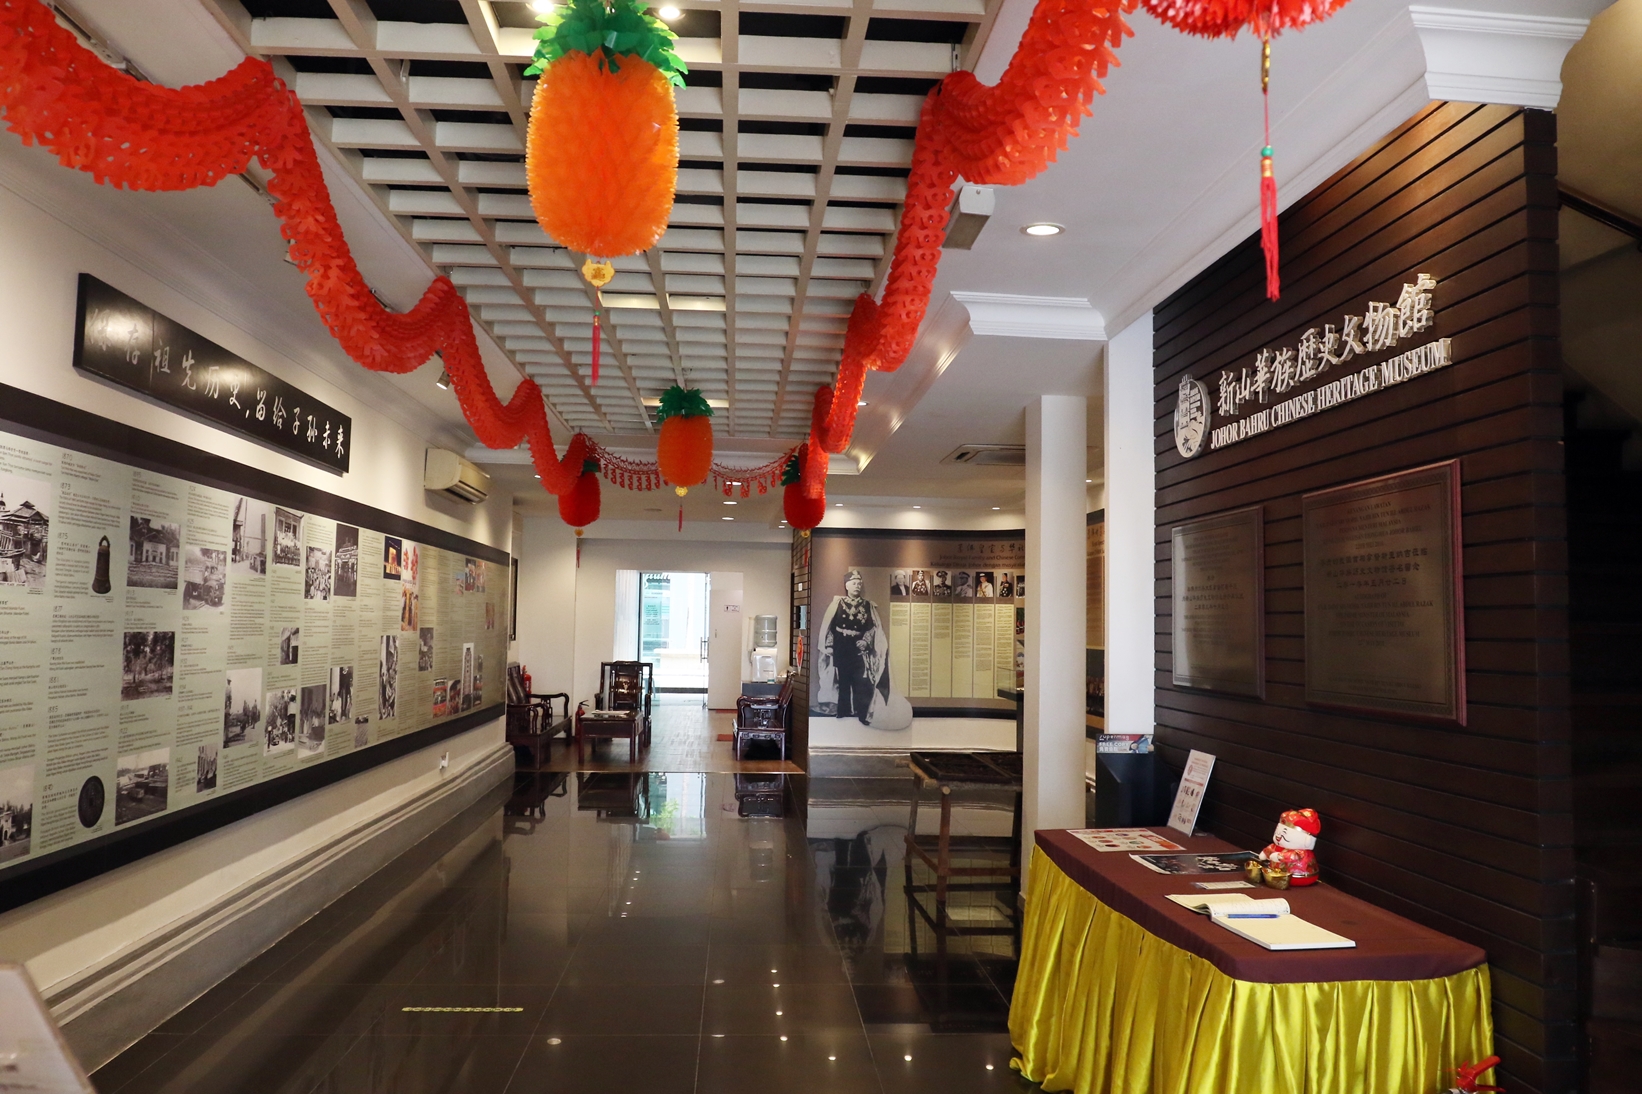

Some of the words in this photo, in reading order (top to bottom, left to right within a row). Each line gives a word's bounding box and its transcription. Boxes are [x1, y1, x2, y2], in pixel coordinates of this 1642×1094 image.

[1211, 422, 1238, 450] JOHOR
[1239, 408, 1271, 440] BAHRU
[1271, 390, 1316, 428] CHINESE
[1316, 364, 1379, 412] HERITAGE
[1380, 337, 1452, 389] MUSEUM
